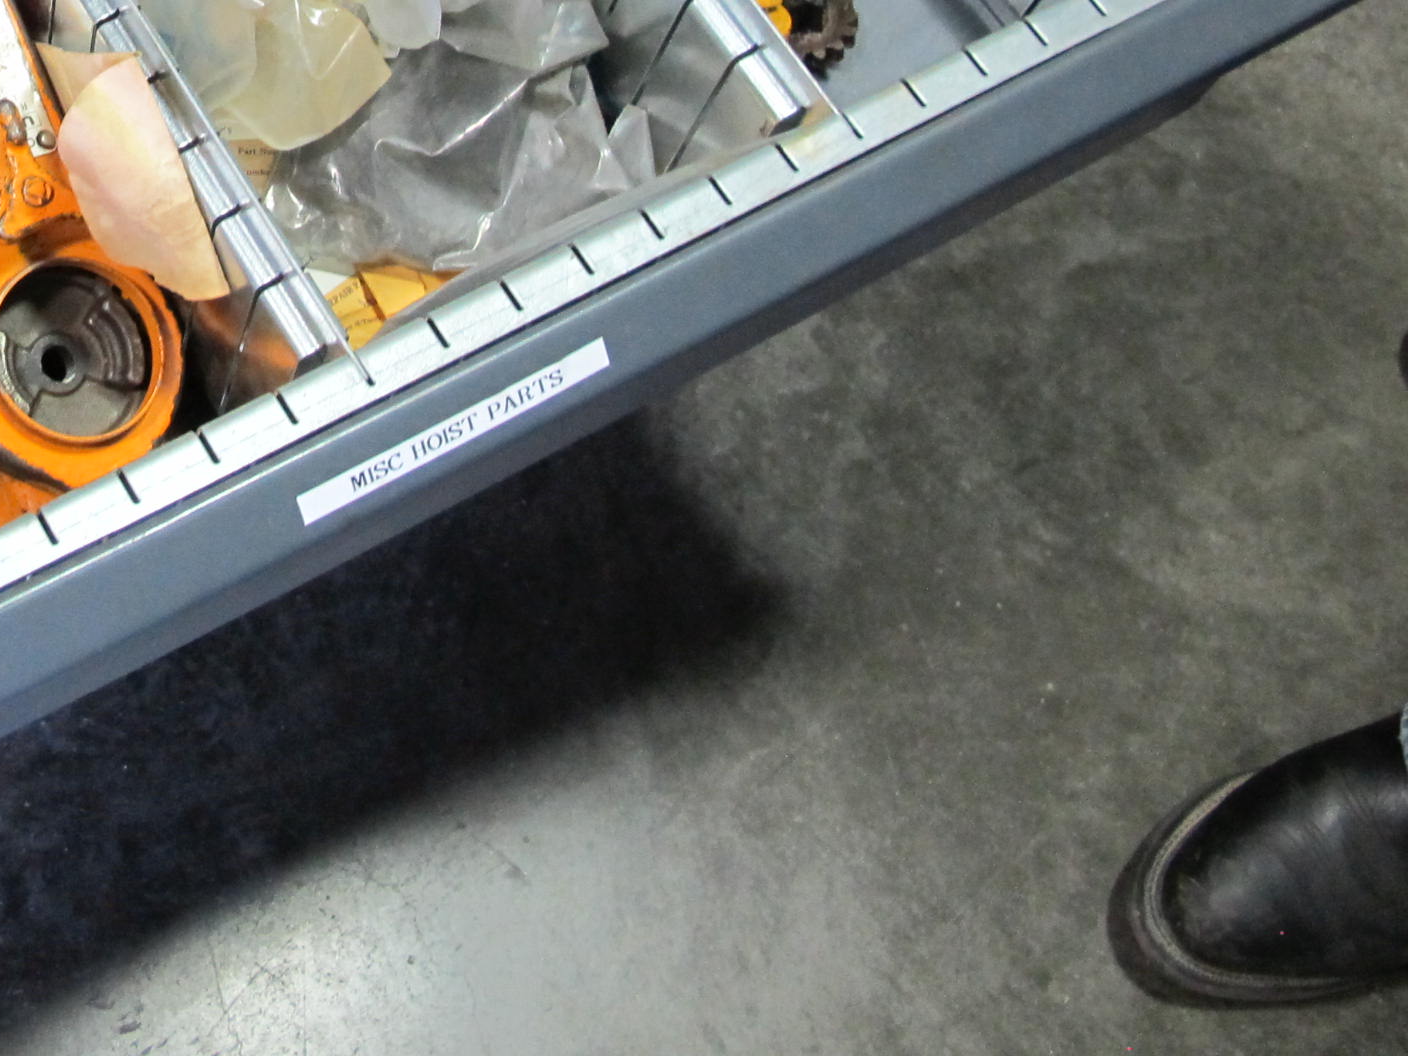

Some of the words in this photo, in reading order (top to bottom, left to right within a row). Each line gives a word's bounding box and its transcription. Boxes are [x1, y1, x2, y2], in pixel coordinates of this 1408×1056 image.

[349, 452, 404, 493] MISC
[411, 411, 479, 461] HOIST
[487, 368, 565, 421] PARTS
